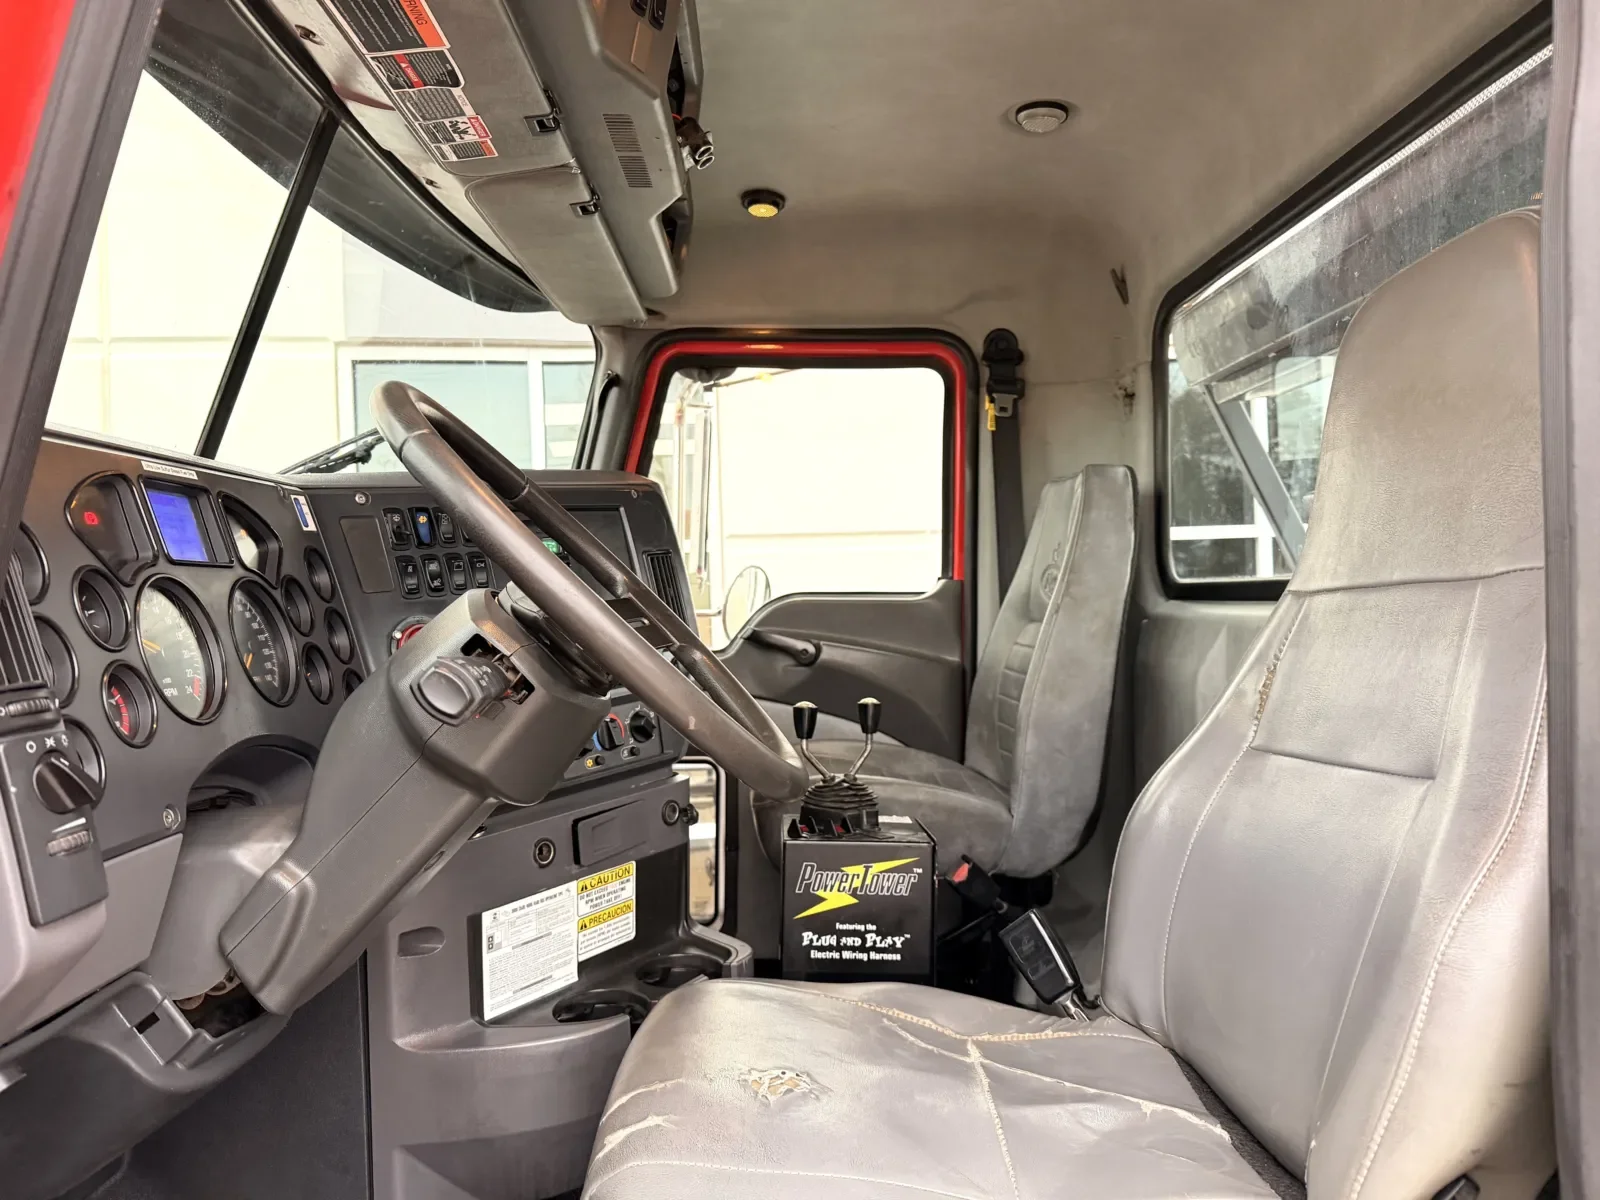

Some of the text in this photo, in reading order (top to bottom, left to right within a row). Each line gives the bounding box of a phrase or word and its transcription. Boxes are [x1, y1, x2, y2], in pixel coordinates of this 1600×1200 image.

[186, 669, 194, 678] 22
[164, 688, 178, 697] RPM
[185, 686, 193, 694] 24
[590, 866, 631, 888] CAUTION
[588, 903, 631, 926] PRECAUCION
[836, 922, 876, 932] Featuring the
[810, 950, 901, 961] Electric Wiring Harness
